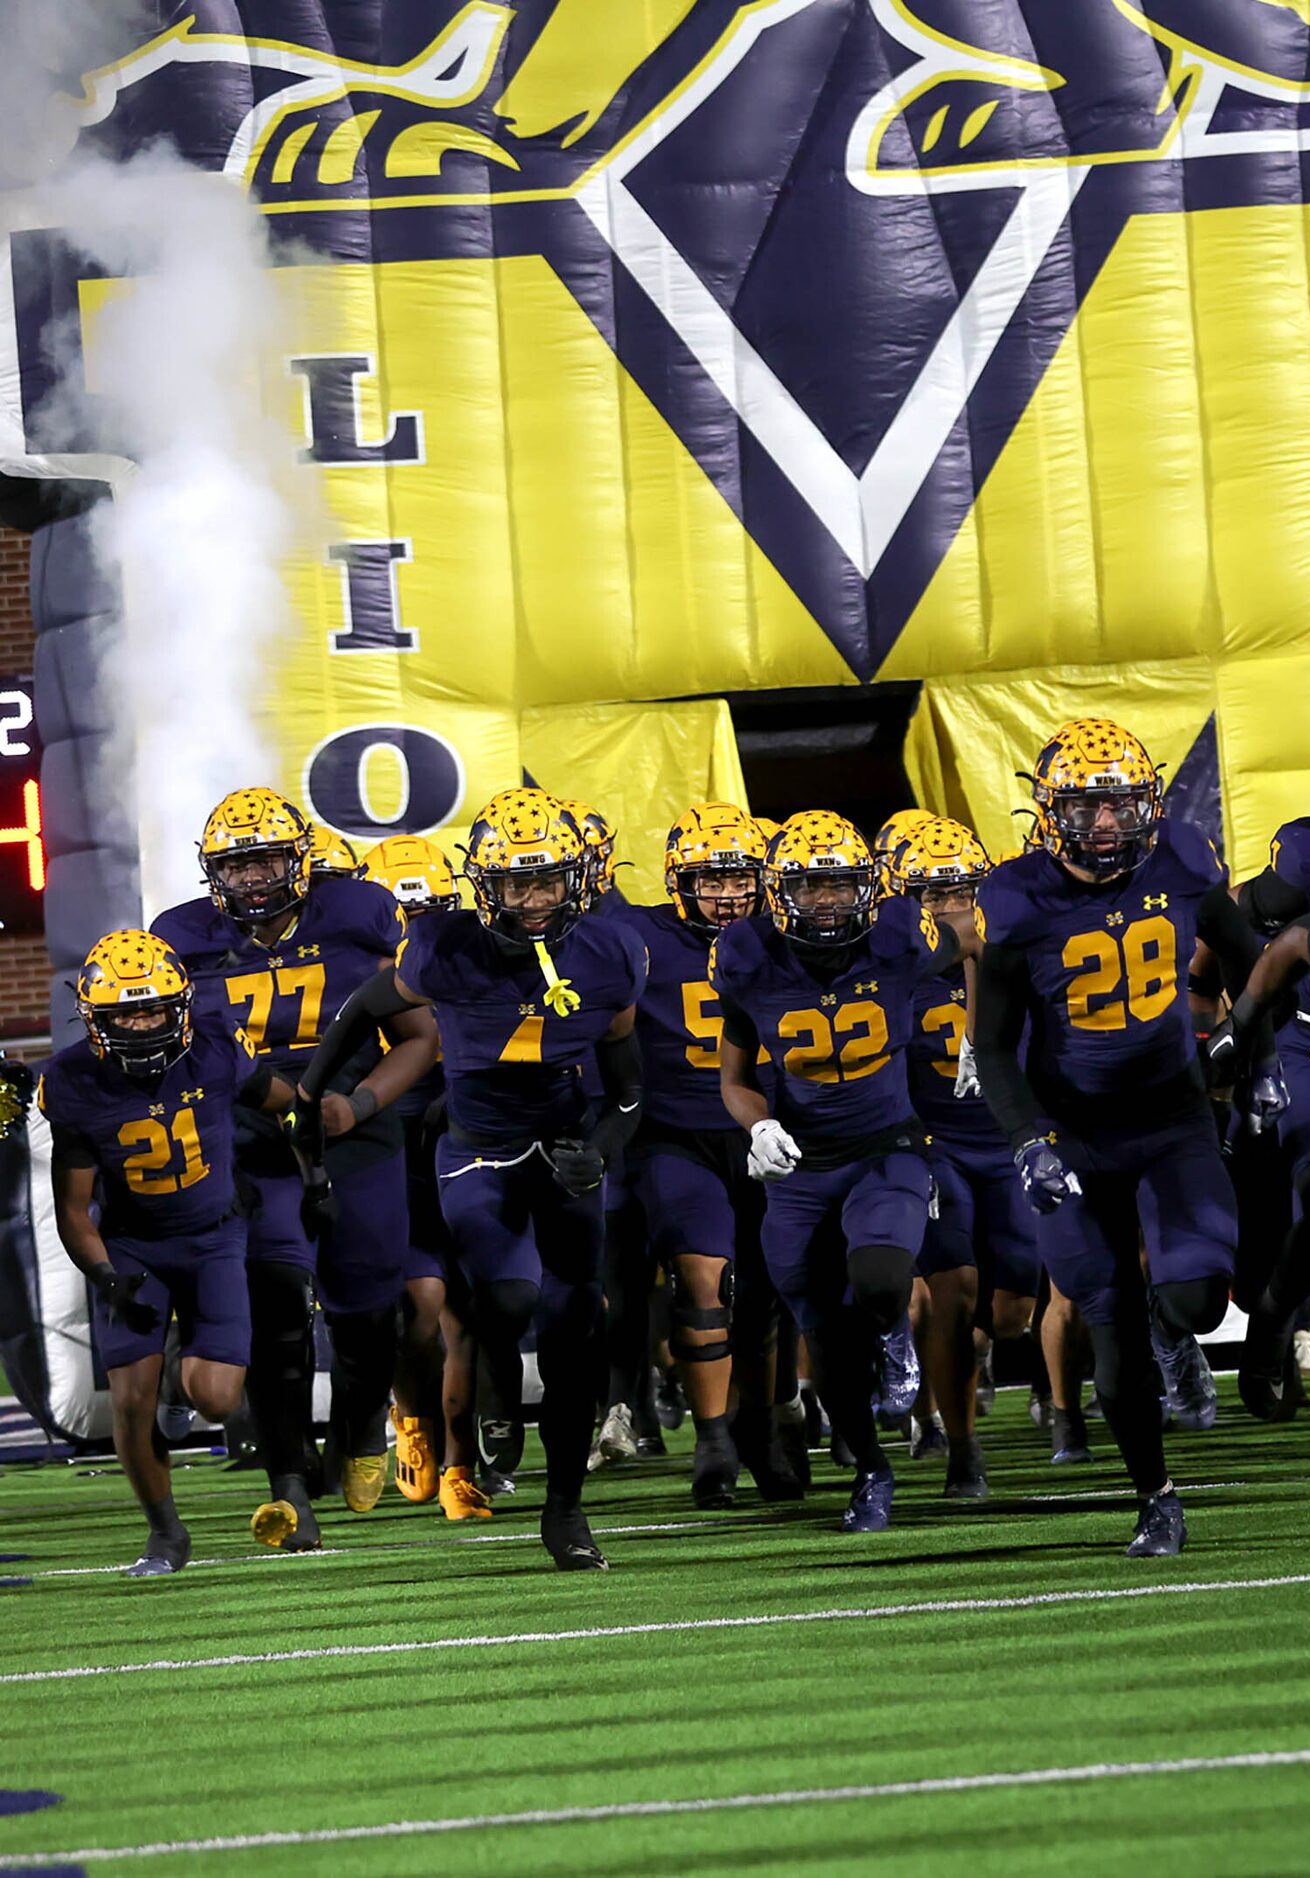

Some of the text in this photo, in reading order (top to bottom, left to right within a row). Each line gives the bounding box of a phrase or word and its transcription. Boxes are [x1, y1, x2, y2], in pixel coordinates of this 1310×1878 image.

[518, 854, 545, 866] WAWG
[126, 986, 151, 997] WAWG
[224, 962, 326, 1056] 77
[1061, 915, 1178, 1031] 28
[777, 998, 892, 1084] 22
[117, 1106, 212, 1196] 21
